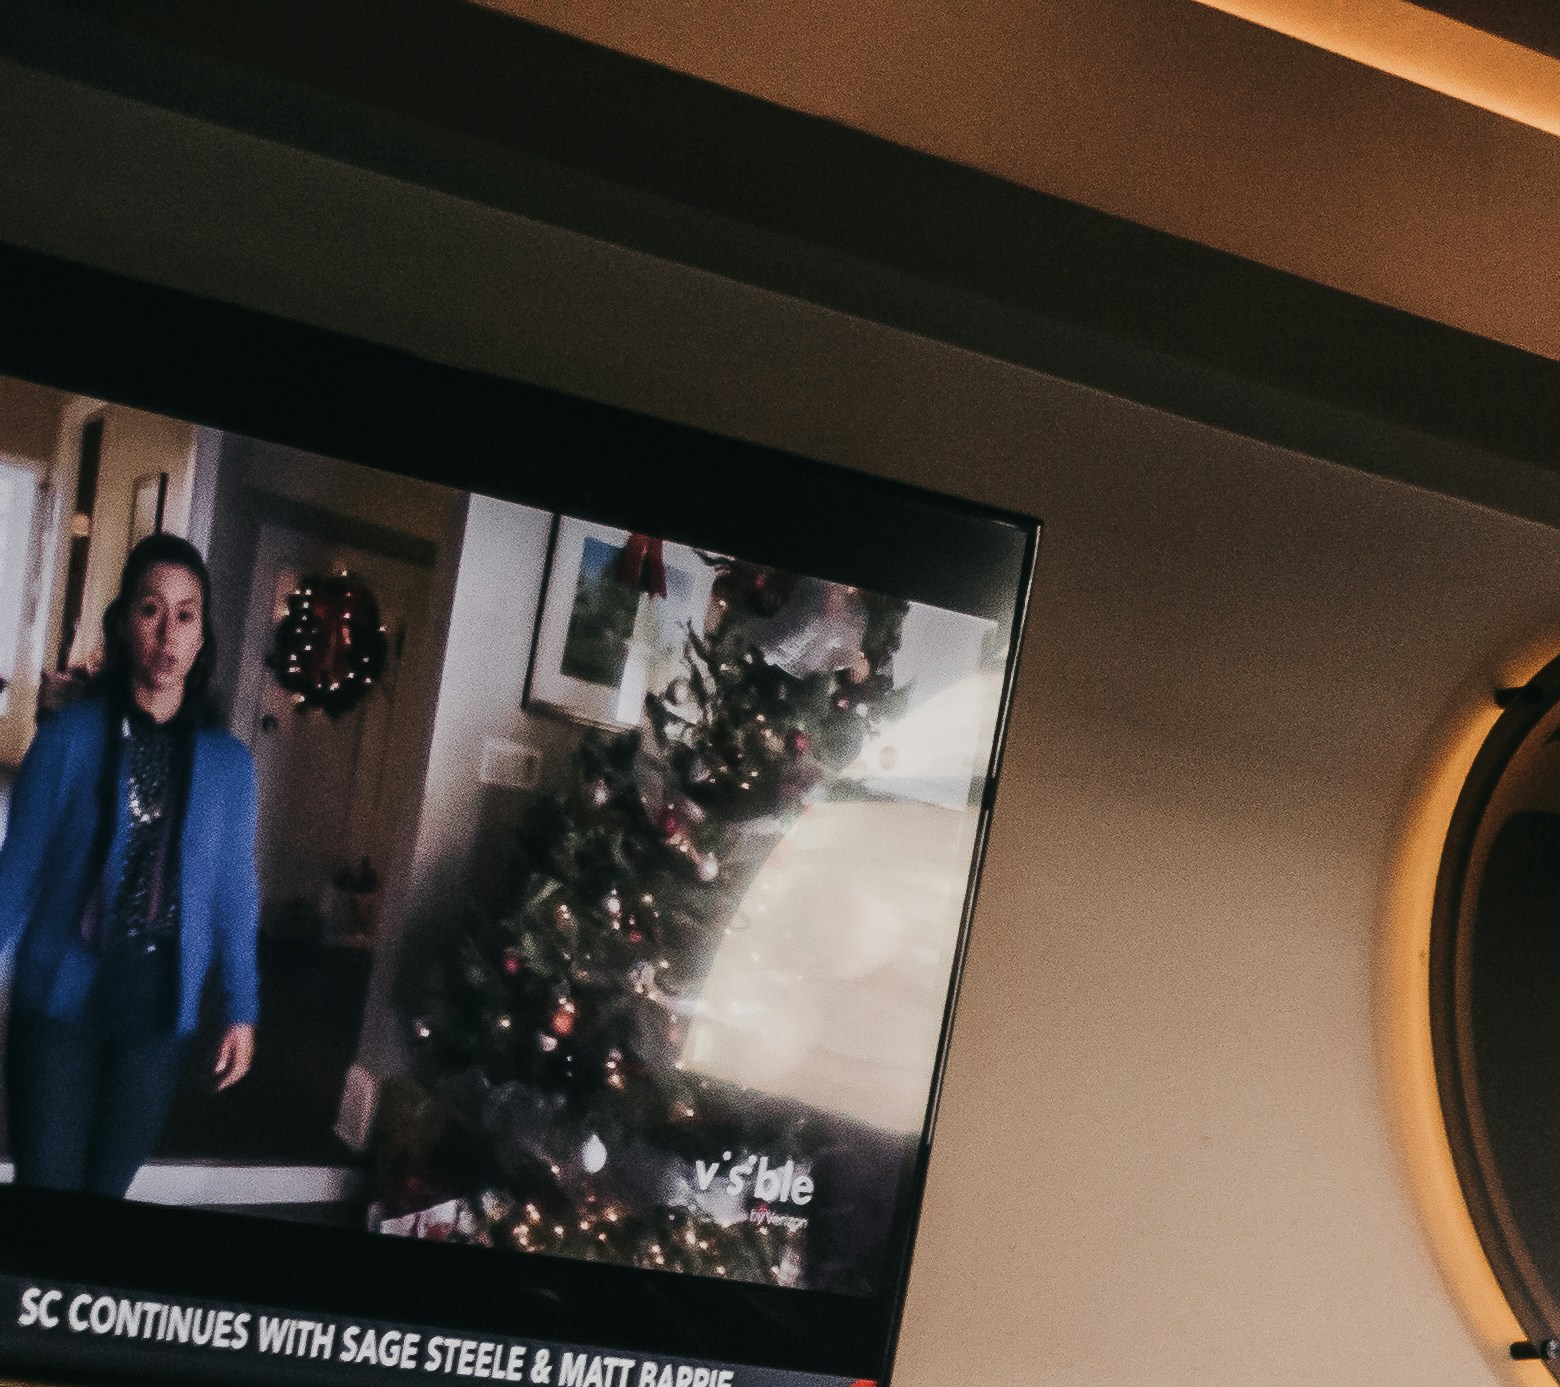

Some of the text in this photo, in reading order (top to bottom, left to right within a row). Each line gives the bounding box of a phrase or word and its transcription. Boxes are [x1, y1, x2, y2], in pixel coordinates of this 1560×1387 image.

[18, 1287, 63, 1328] SC
[68, 1293, 251, 1350] CONTINUES
[258, 1315, 336, 1359] WITH
[338, 1326, 421, 1369] SAGE
[423, 1335, 528, 1382] STEELE
[530, 1349, 553, 1384] &
